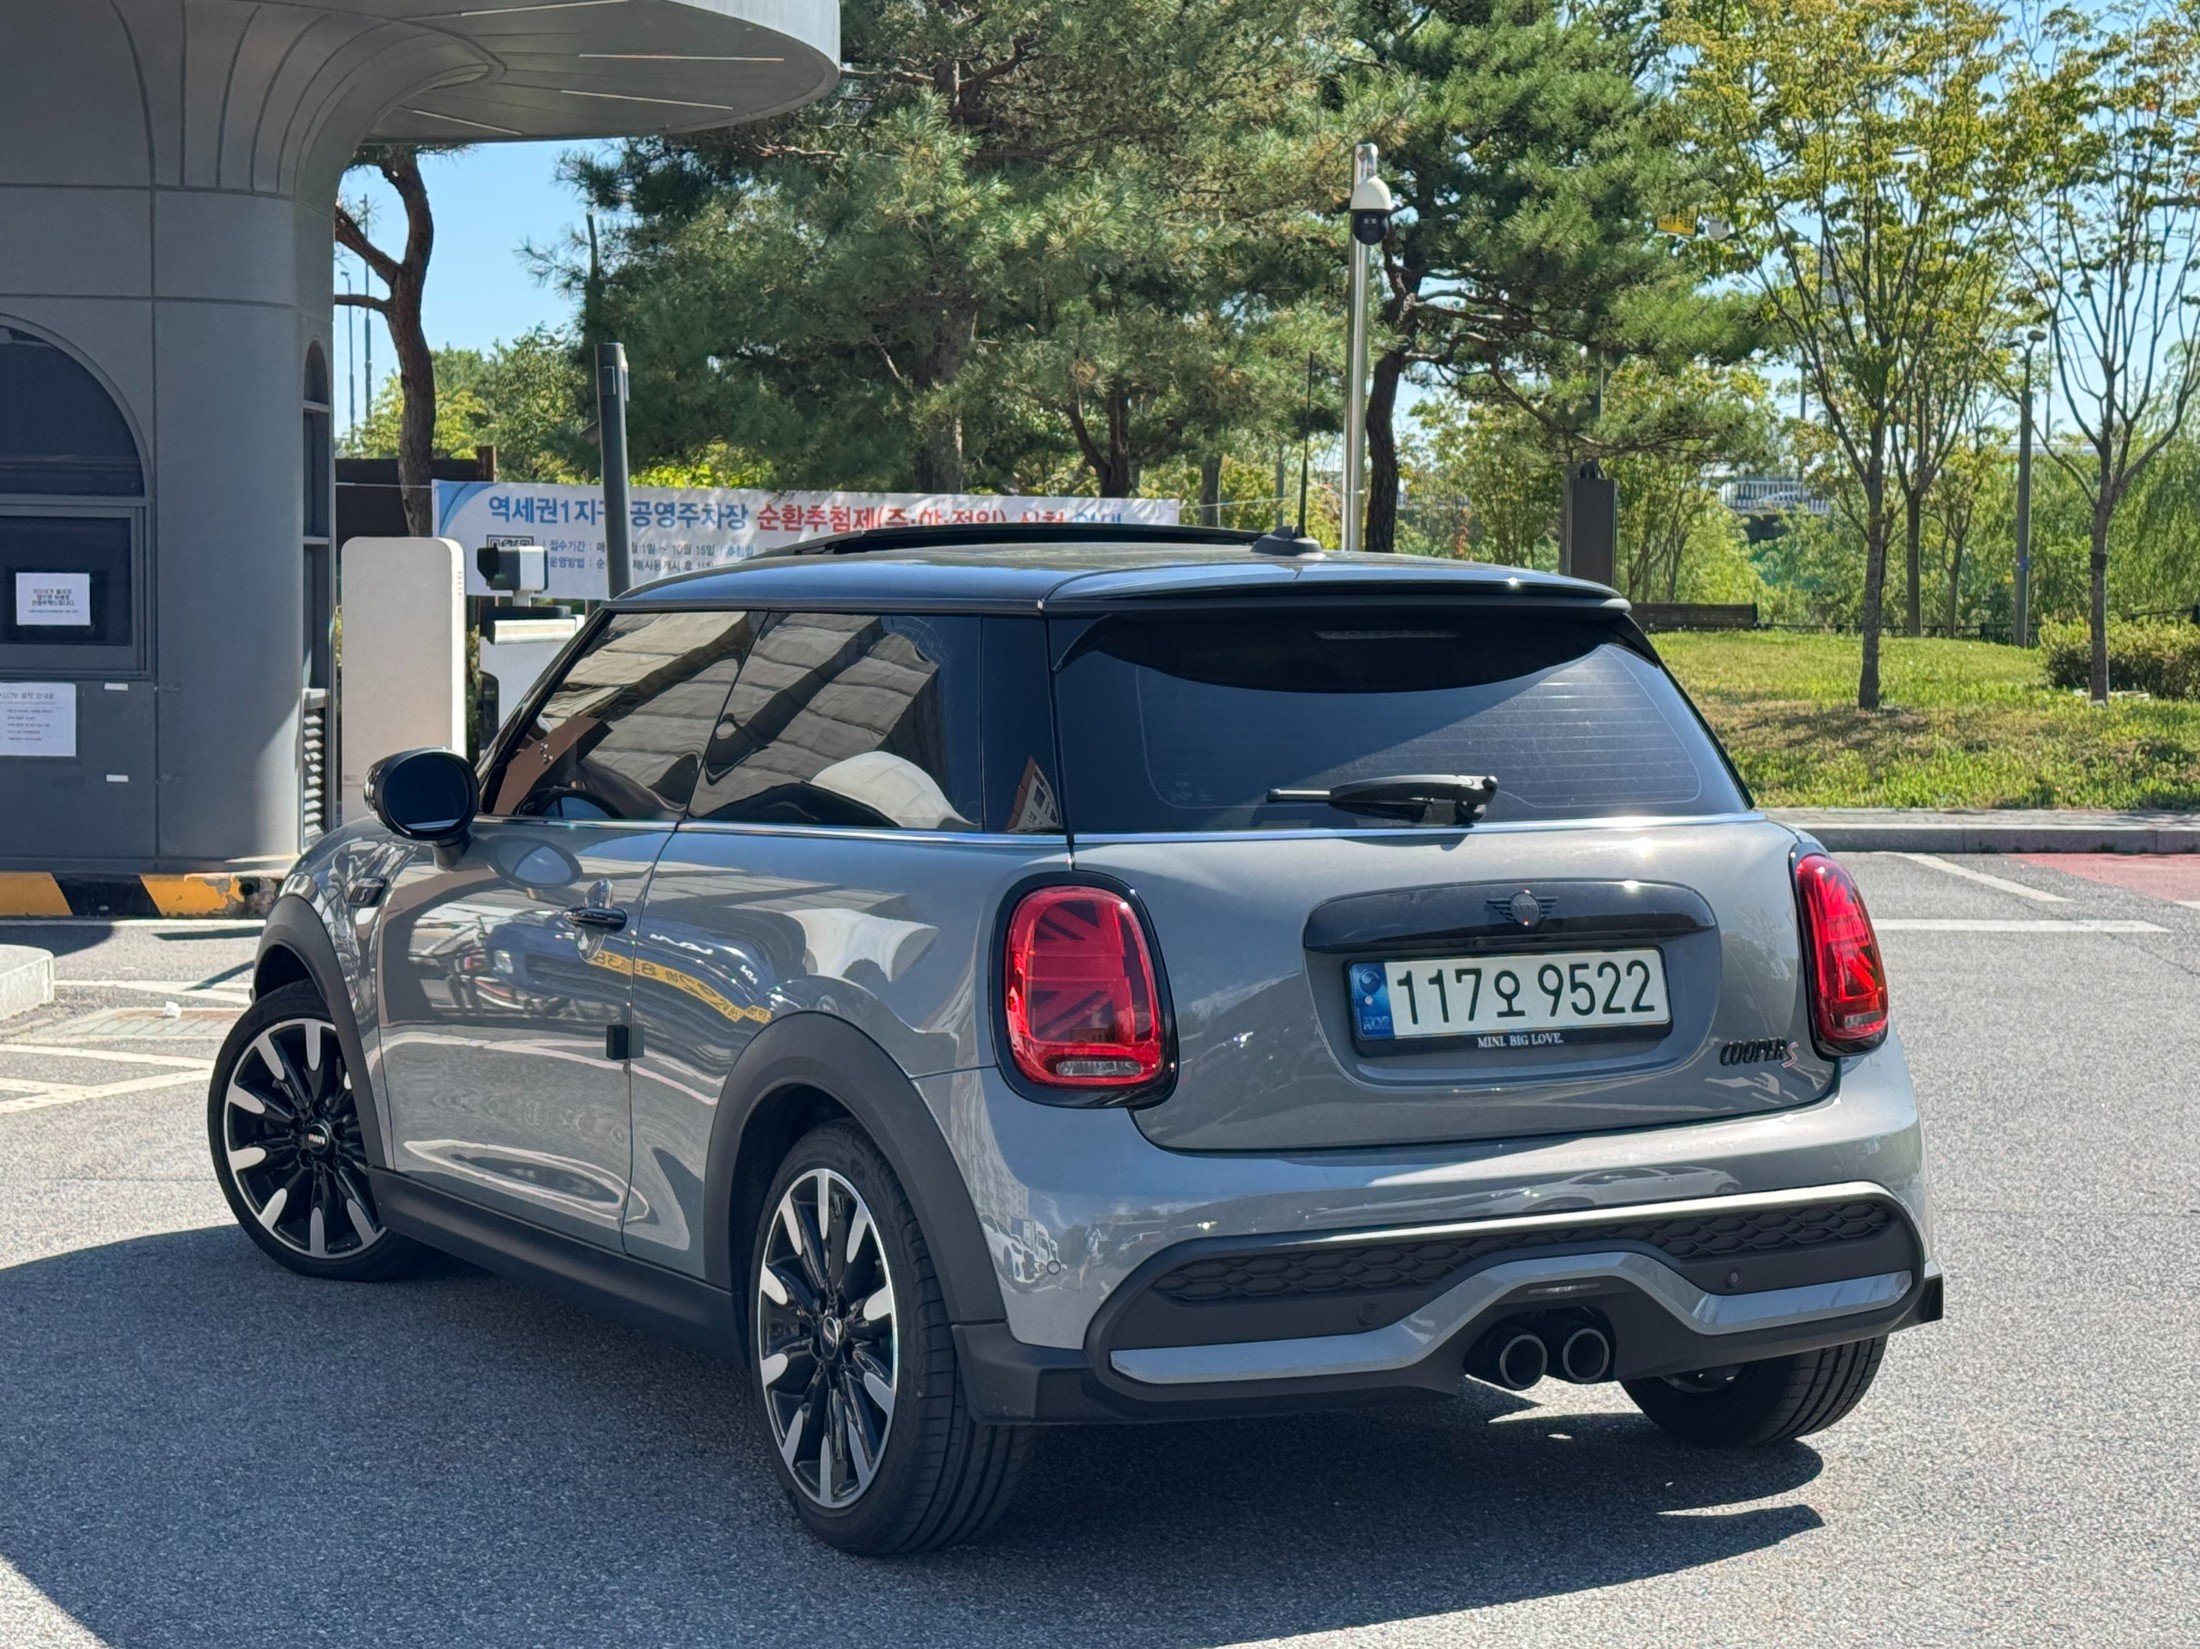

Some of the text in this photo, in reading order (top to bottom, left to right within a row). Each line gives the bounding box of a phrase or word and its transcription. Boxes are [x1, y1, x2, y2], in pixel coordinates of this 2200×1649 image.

[630, 501, 748, 530] 공영주차장
[550, 540, 586, 552] 접수기간
[673, 544, 692, 555] 10월
[695, 545, 715, 556] 15일
[549, 556, 585, 569] 운영방법
[1396, 959, 1656, 1025] 117오 9522
[1509, 1034, 1530, 1047] BIG
[1720, 1039, 1800, 1068] COOPER S
